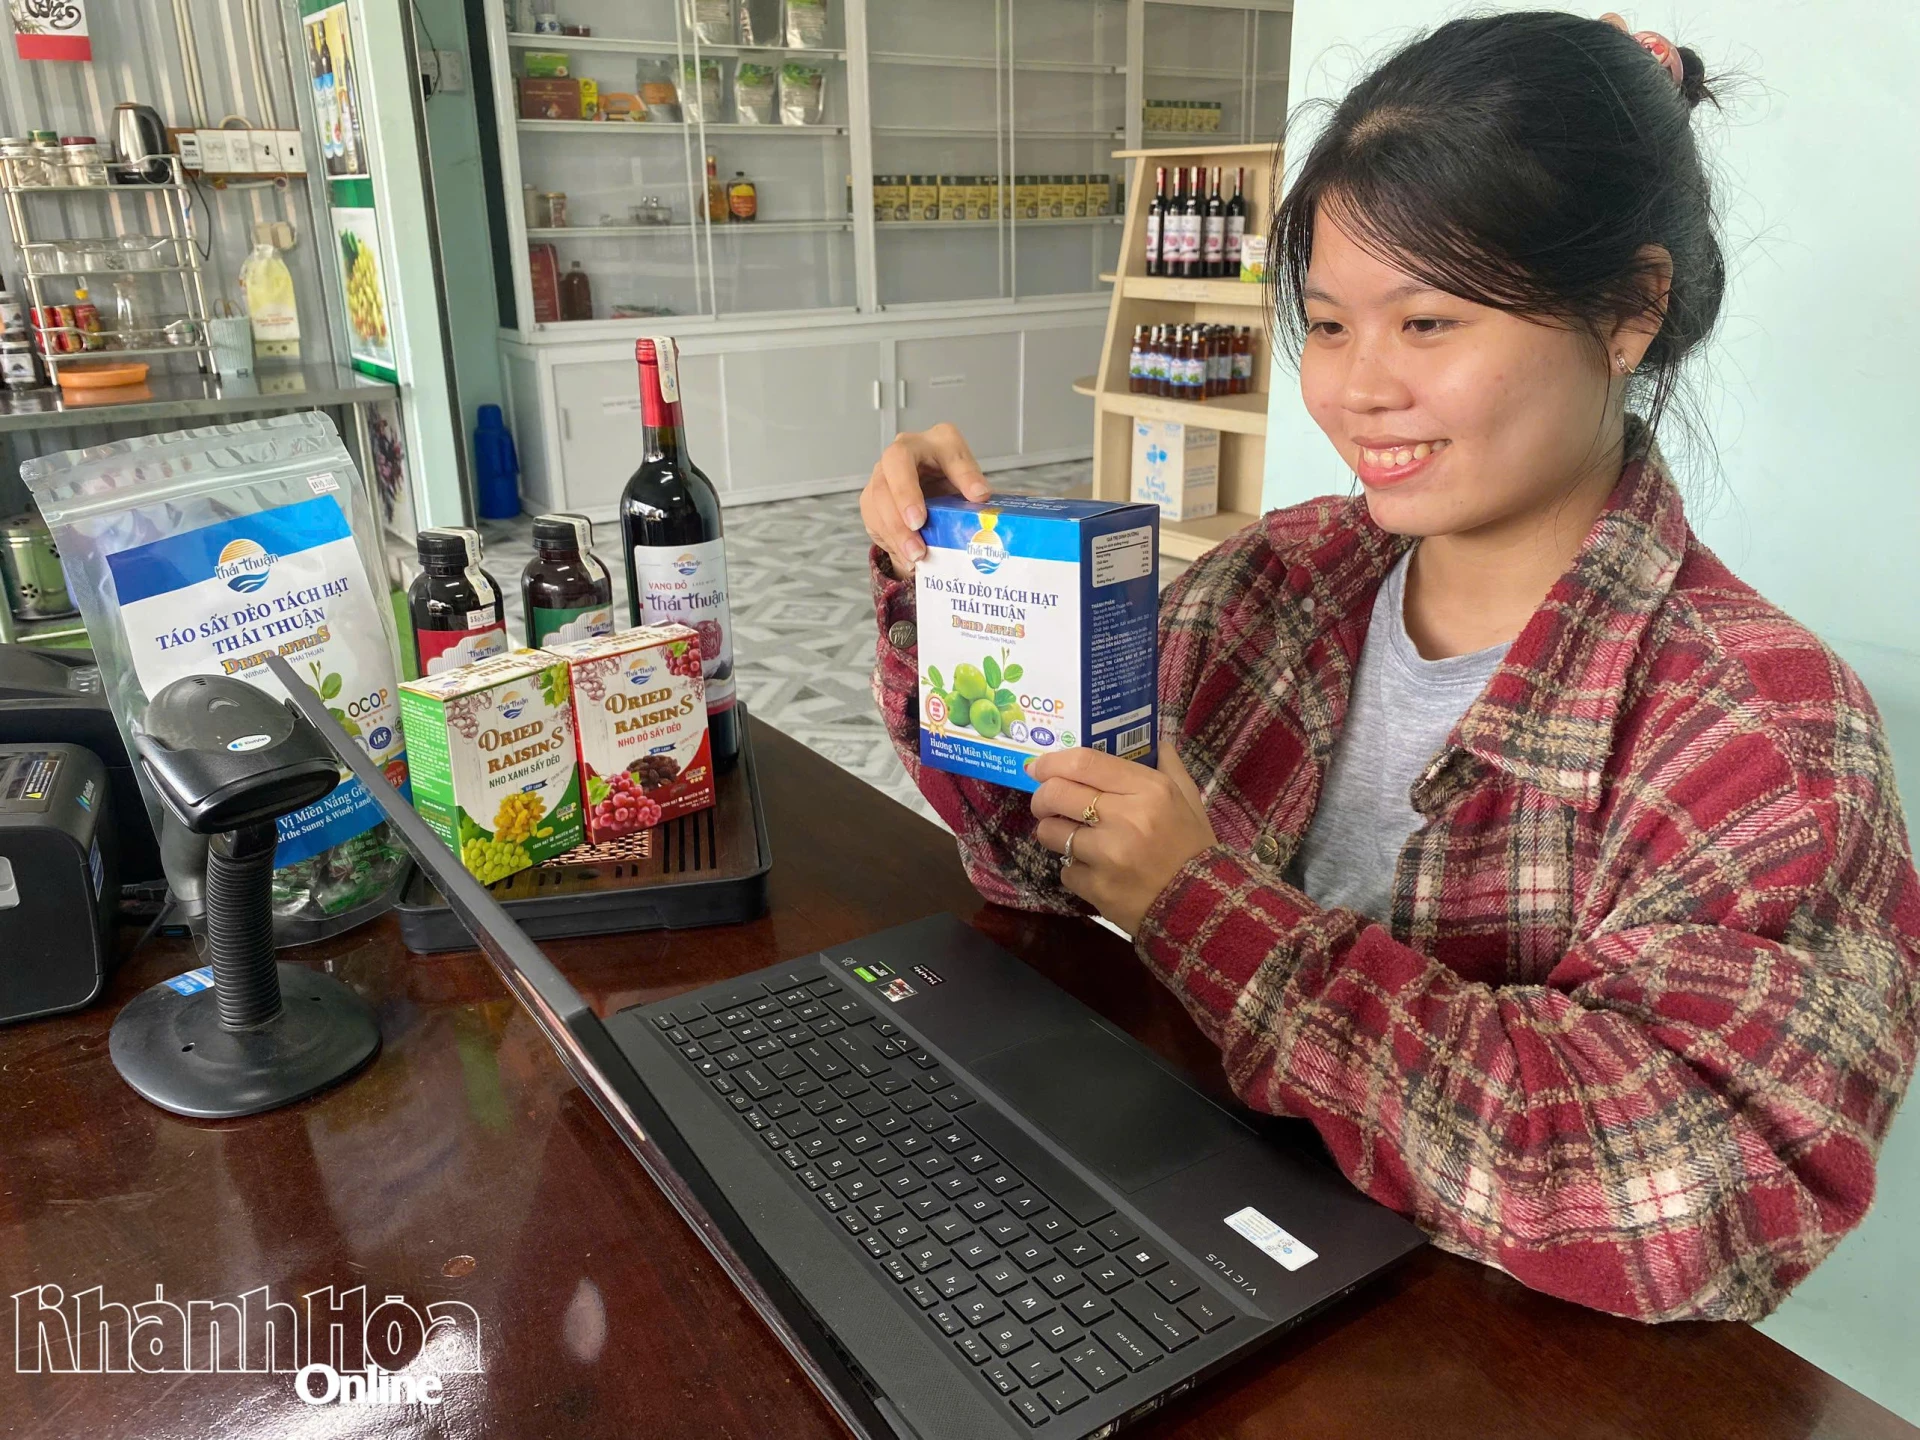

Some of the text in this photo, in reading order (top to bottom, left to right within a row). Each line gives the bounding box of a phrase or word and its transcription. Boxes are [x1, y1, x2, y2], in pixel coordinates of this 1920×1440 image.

[648, 582, 672, 590] VANG
[924, 574, 943, 590] TÁO
[945, 578, 966, 595] SẤY
[994, 586, 1028, 603] TÁCH
[1030, 593, 1059, 609] HẠT
[156, 577, 349, 650] TÁO SẤY DẺO TÁCH HẠT
[950, 598, 1026, 623] THÁI THUẬN
[212, 607, 326, 655] THÁI THUẬN
[243, 666, 270, 679] Without
[348, 688, 388, 718] OCOP
[605, 687, 673, 714] DRIED
[1019, 694, 1064, 714] OCOP
[614, 694, 694, 734] RAISINS
[374, 731, 388, 745] IAF
[478, 720, 544, 751] DRIED
[618, 736, 635, 748] NHO
[650, 725, 665, 739] SẤY
[1035, 731, 1050, 741] IAF
[487, 726, 565, 774] RAISINS
[930, 738, 1017, 767] Hương Vị Miền Nắng Gió
[935, 749, 949, 758] flavor
[964, 757, 980, 768] Sunny
[985, 762, 1003, 773] Windy
[1003, 766, 1017, 775] Land
[489, 775, 506, 789] NHO
[508, 768, 529, 782] XANH
[530, 759, 545, 773] SẤY
[279, 815, 295, 829] Vị
[294, 805, 324, 824] Miền
[324, 793, 352, 811] Nắng
[287, 829, 301, 839] the
[301, 818, 325, 834] Sunny
[325, 815, 332, 823] &
[332, 804, 354, 819] Windy
[834, 1116, 847, 1124] P
[883, 1117, 895, 1125] L
[854, 1135, 867, 1143] O
[904, 1137, 916, 1145] K
[947, 1133, 960, 1142] M
[926, 1157, 938, 1165] J
[970, 1153, 983, 1162] N
[831, 1159, 842, 1167] 9
[897, 1177, 910, 1185] U
[948, 1178, 961, 1187] H
[994, 1175, 1007, 1183] B
[852, 1181, 864, 1189] 8
[920, 1199, 933, 1207] Y
[972, 1200, 986, 1209] G
[1019, 1197, 1032, 1205] V
[873, 1203, 885, 1211] 7
[944, 1222, 957, 1230] T
[997, 1223, 1011, 1233] F
[1045, 1220, 1059, 1229] C
[896, 1226, 909, 1234] 6
[968, 1246, 982, 1255] R
[1024, 1248, 1038, 1257] D
[1072, 1244, 1086, 1253] X
[921, 1250, 933, 1258] 5
[994, 1271, 1008, 1280] E
[1051, 1273, 1066, 1283] S
[1101, 1269, 1115, 1278] Z
[1205, 1253, 1257, 1296] VICTUS
[945, 1275, 957, 1284] 4
[972, 1302, 985, 1311] 3
[1021, 1296, 1038, 1308] W
[1080, 1299, 1095, 1309] A
[999, 1330, 1013, 1339] 2
[1050, 1325, 1066, 1335] Q
